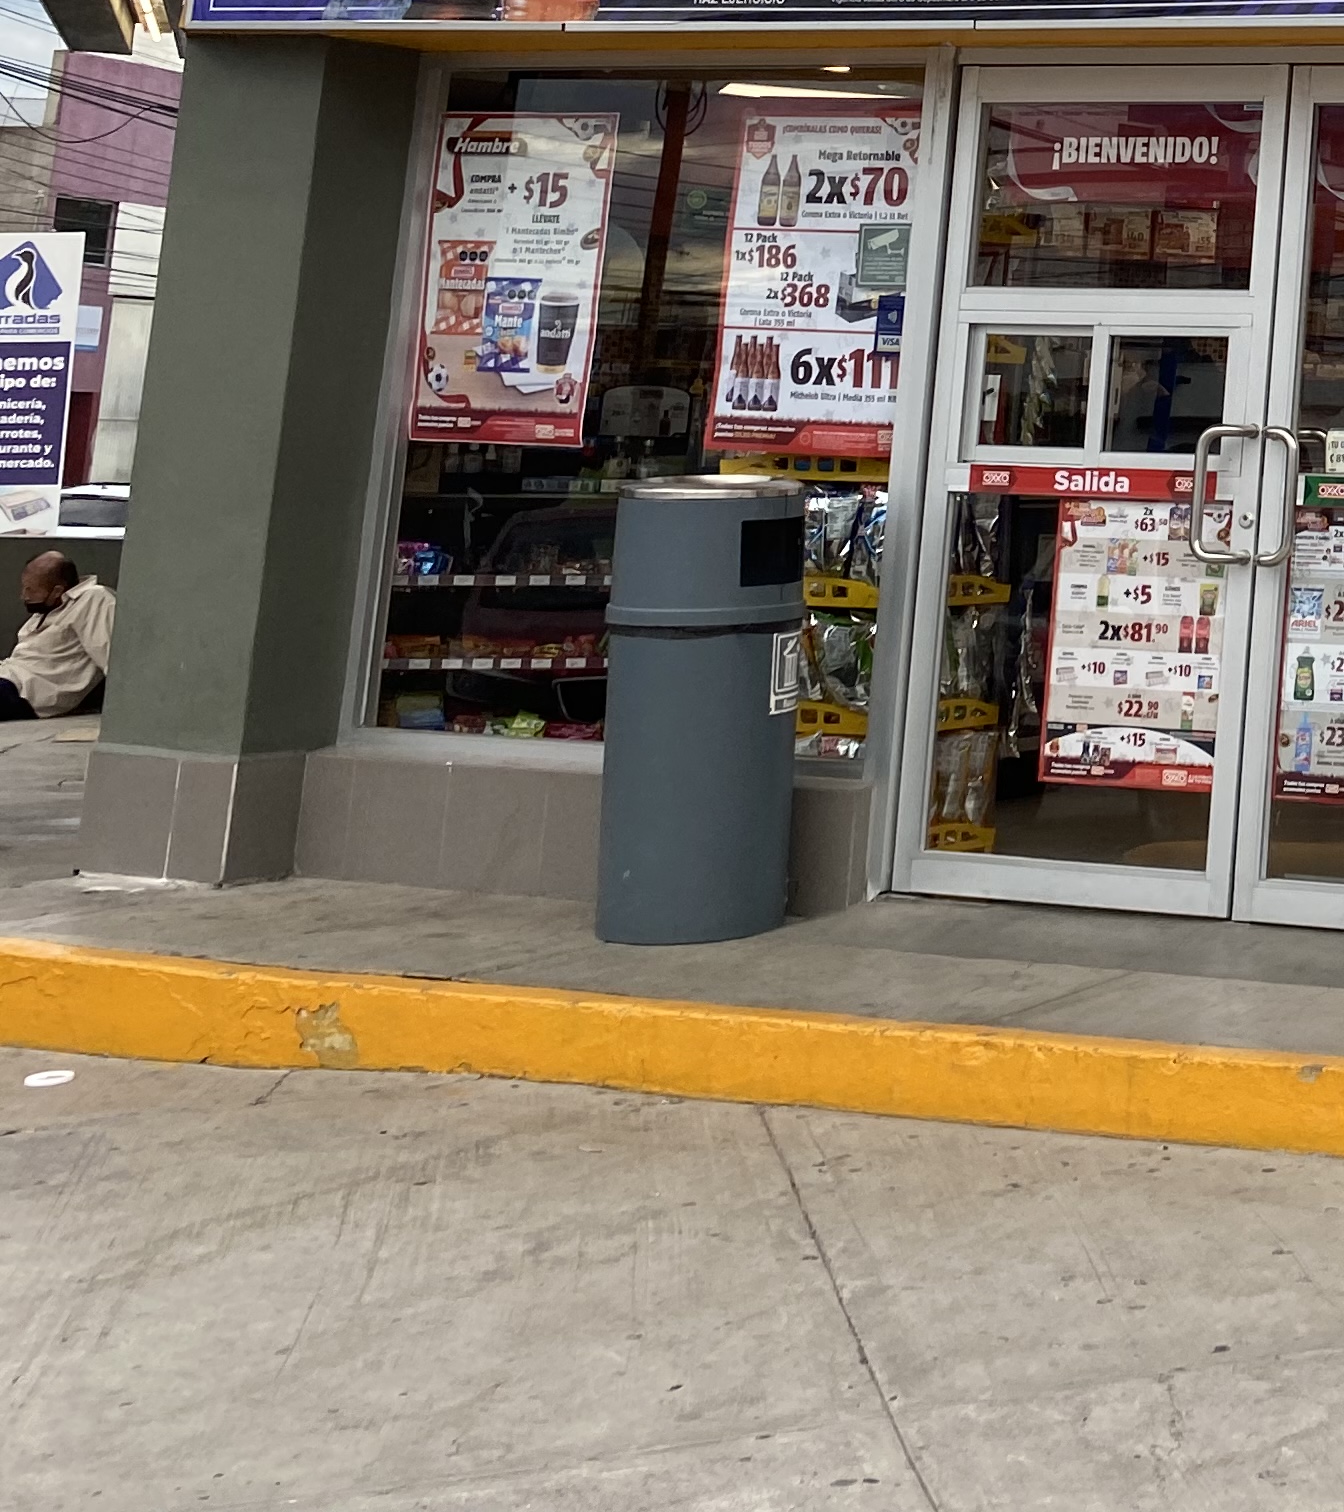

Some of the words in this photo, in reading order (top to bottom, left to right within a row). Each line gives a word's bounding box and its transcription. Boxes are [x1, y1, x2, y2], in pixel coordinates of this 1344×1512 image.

[453, 137, 520, 154] Hambre
[1051, 134, 1220, 171] ¡BIENVENIDO!
[817, 149, 844, 163] Mega
[846, 149, 901, 162] Retornable
[523, 171, 570, 209] $15
[805, 166, 909, 207] 2x$70
[744, 233, 753, 243] 12
[756, 232, 778, 244] Pack
[779, 272, 789, 282] 12
[791, 272, 814, 282] Pack
[882, 337, 900, 346] VISA
[29, 374, 57, 389] de:
[44, 444, 53, 456] y
[982, 473, 1010, 484] OXXO
[1053, 470, 1131, 494] Salida
[1175, 479, 1193, 490] OXX
[1290, 619, 1317, 628] ARIEL
